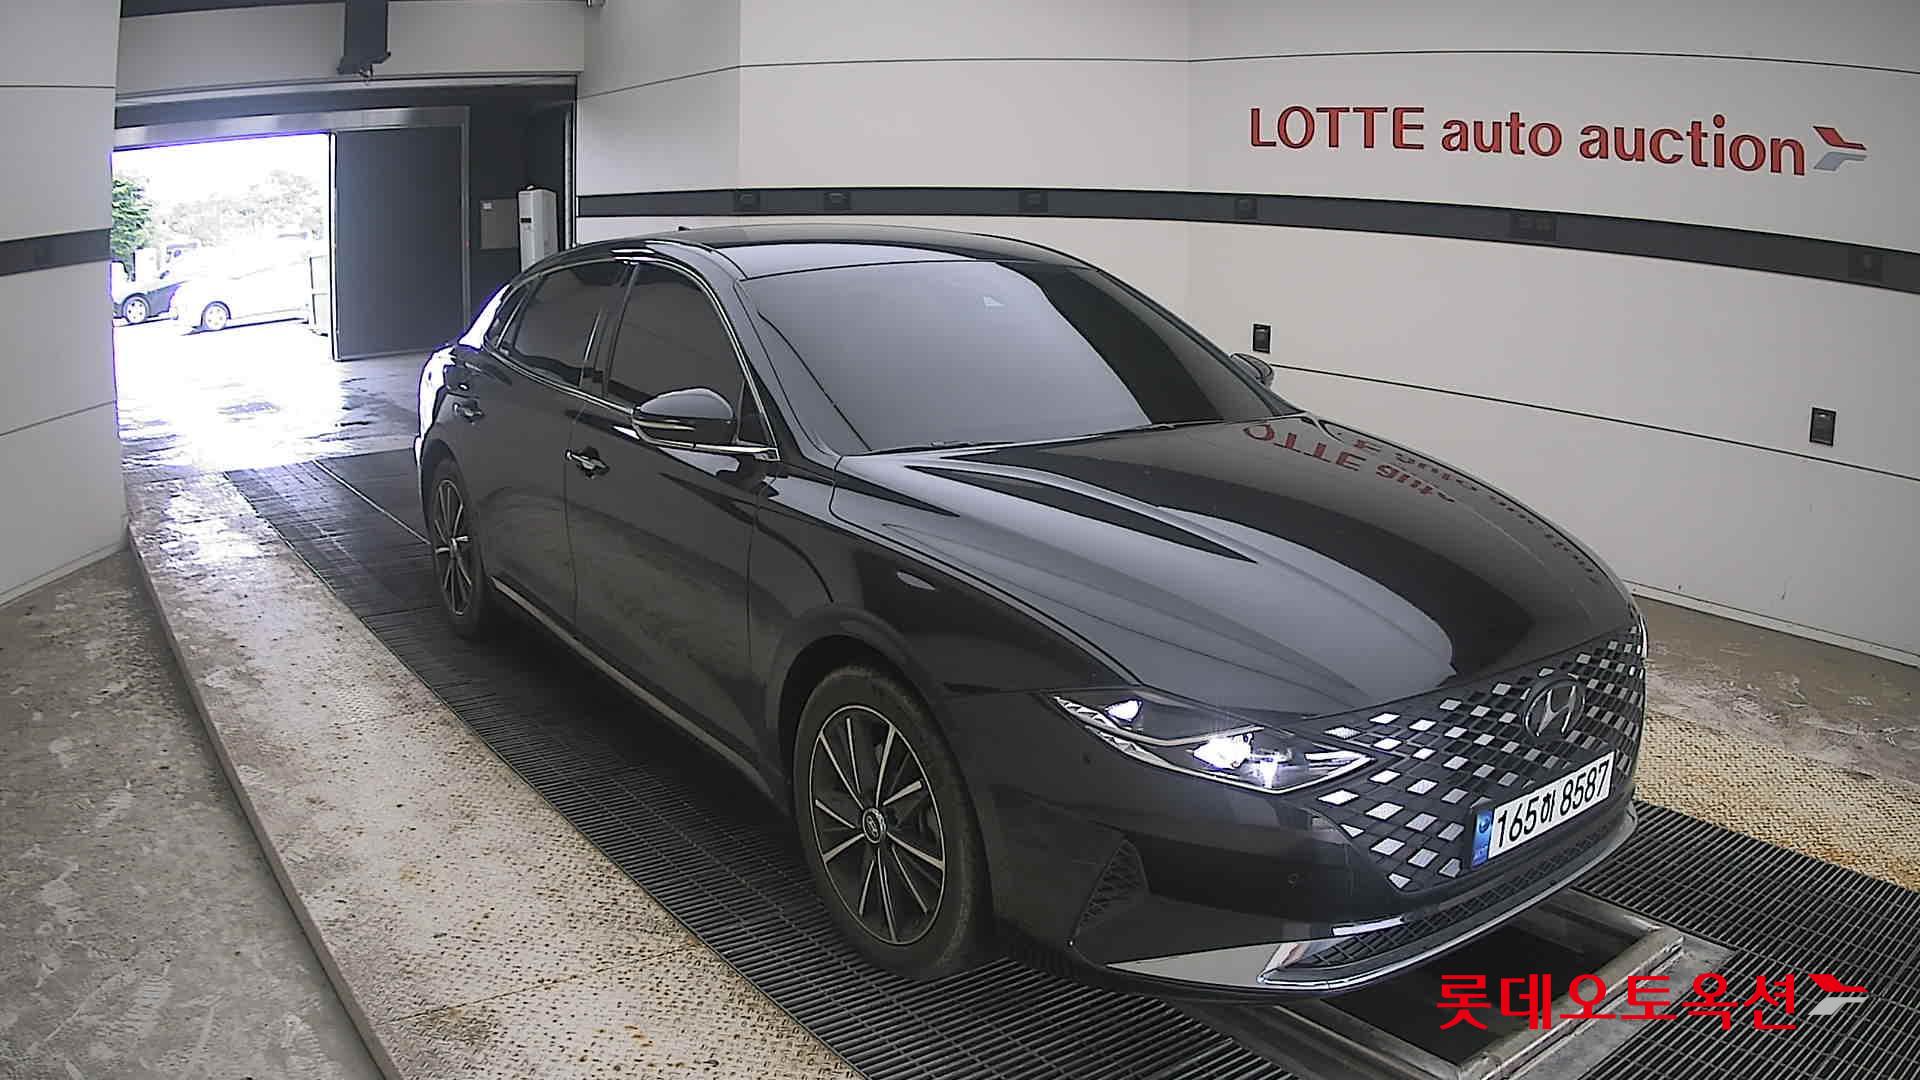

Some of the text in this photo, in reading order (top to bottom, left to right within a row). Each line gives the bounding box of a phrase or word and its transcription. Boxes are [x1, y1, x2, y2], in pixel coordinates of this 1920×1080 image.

[1250, 106, 1806, 176] LOTTE auto auction
[1559, 759, 1610, 816] 8587
